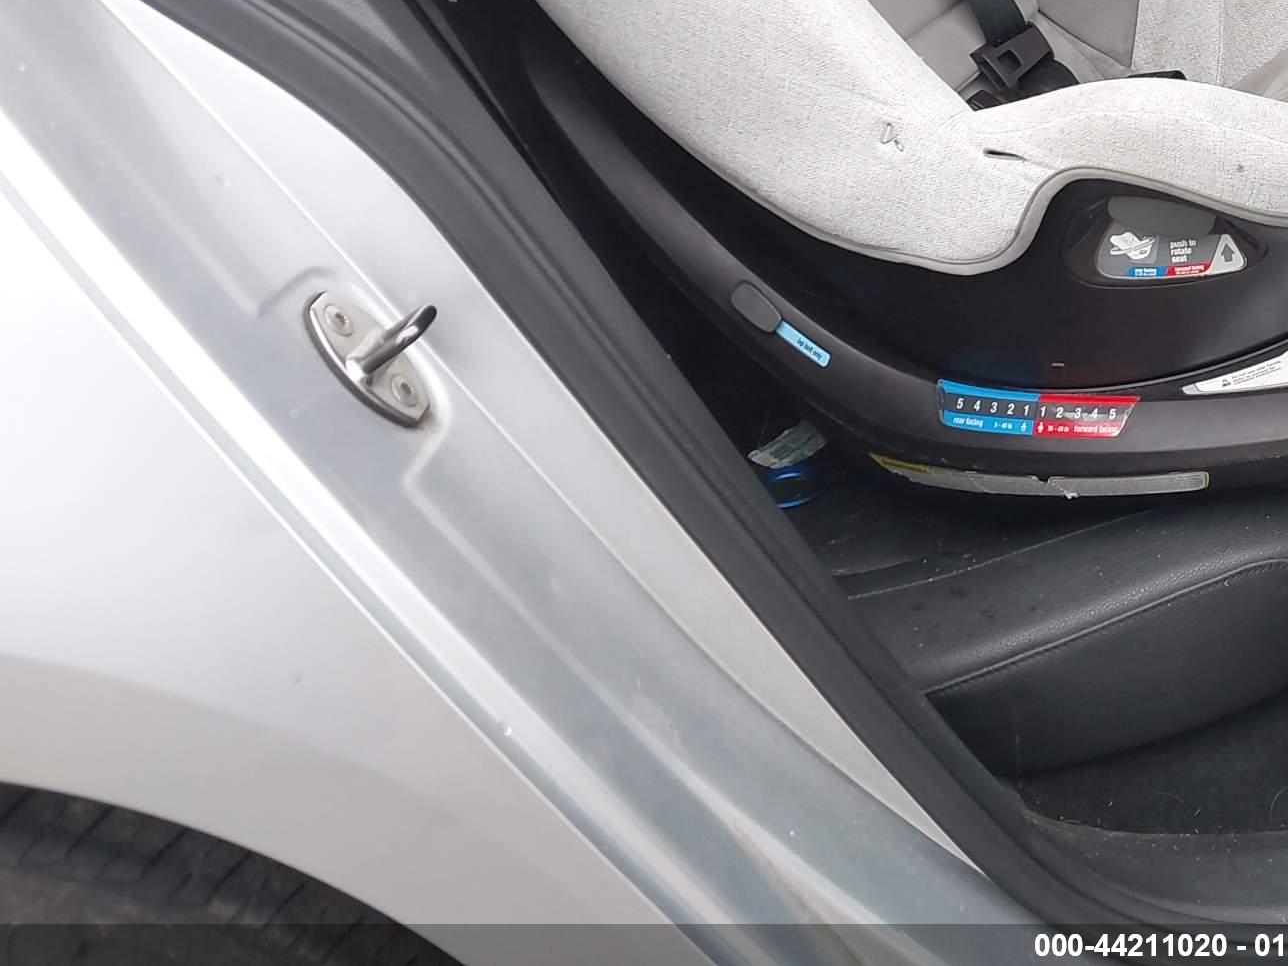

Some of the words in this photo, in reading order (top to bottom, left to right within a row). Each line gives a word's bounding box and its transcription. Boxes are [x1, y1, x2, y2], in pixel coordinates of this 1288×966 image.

[1170, 239, 1188, 250] push
[1189, 238, 1197, 247] to
[1170, 246, 1192, 256] rotate
[1171, 254, 1188, 264] seat
[956, 397, 964, 410] 5
[973, 399, 981, 412] 4
[989, 401, 998, 414] 3
[1006, 403, 1015, 415] 2
[1023, 404, 1030, 417] 1
[1040, 405, 1047, 418] 1
[1055, 406, 1064, 419] 2
[1074, 407, 1082, 419] 3
[1091, 407, 1099, 419] 4
[1108, 408, 1117, 420] 5
[952, 416, 965, 425] rear
[965, 418, 984, 429] facing
[1073, 424, 1098, 433] forward
[1098, 424, 1119, 435] facing
